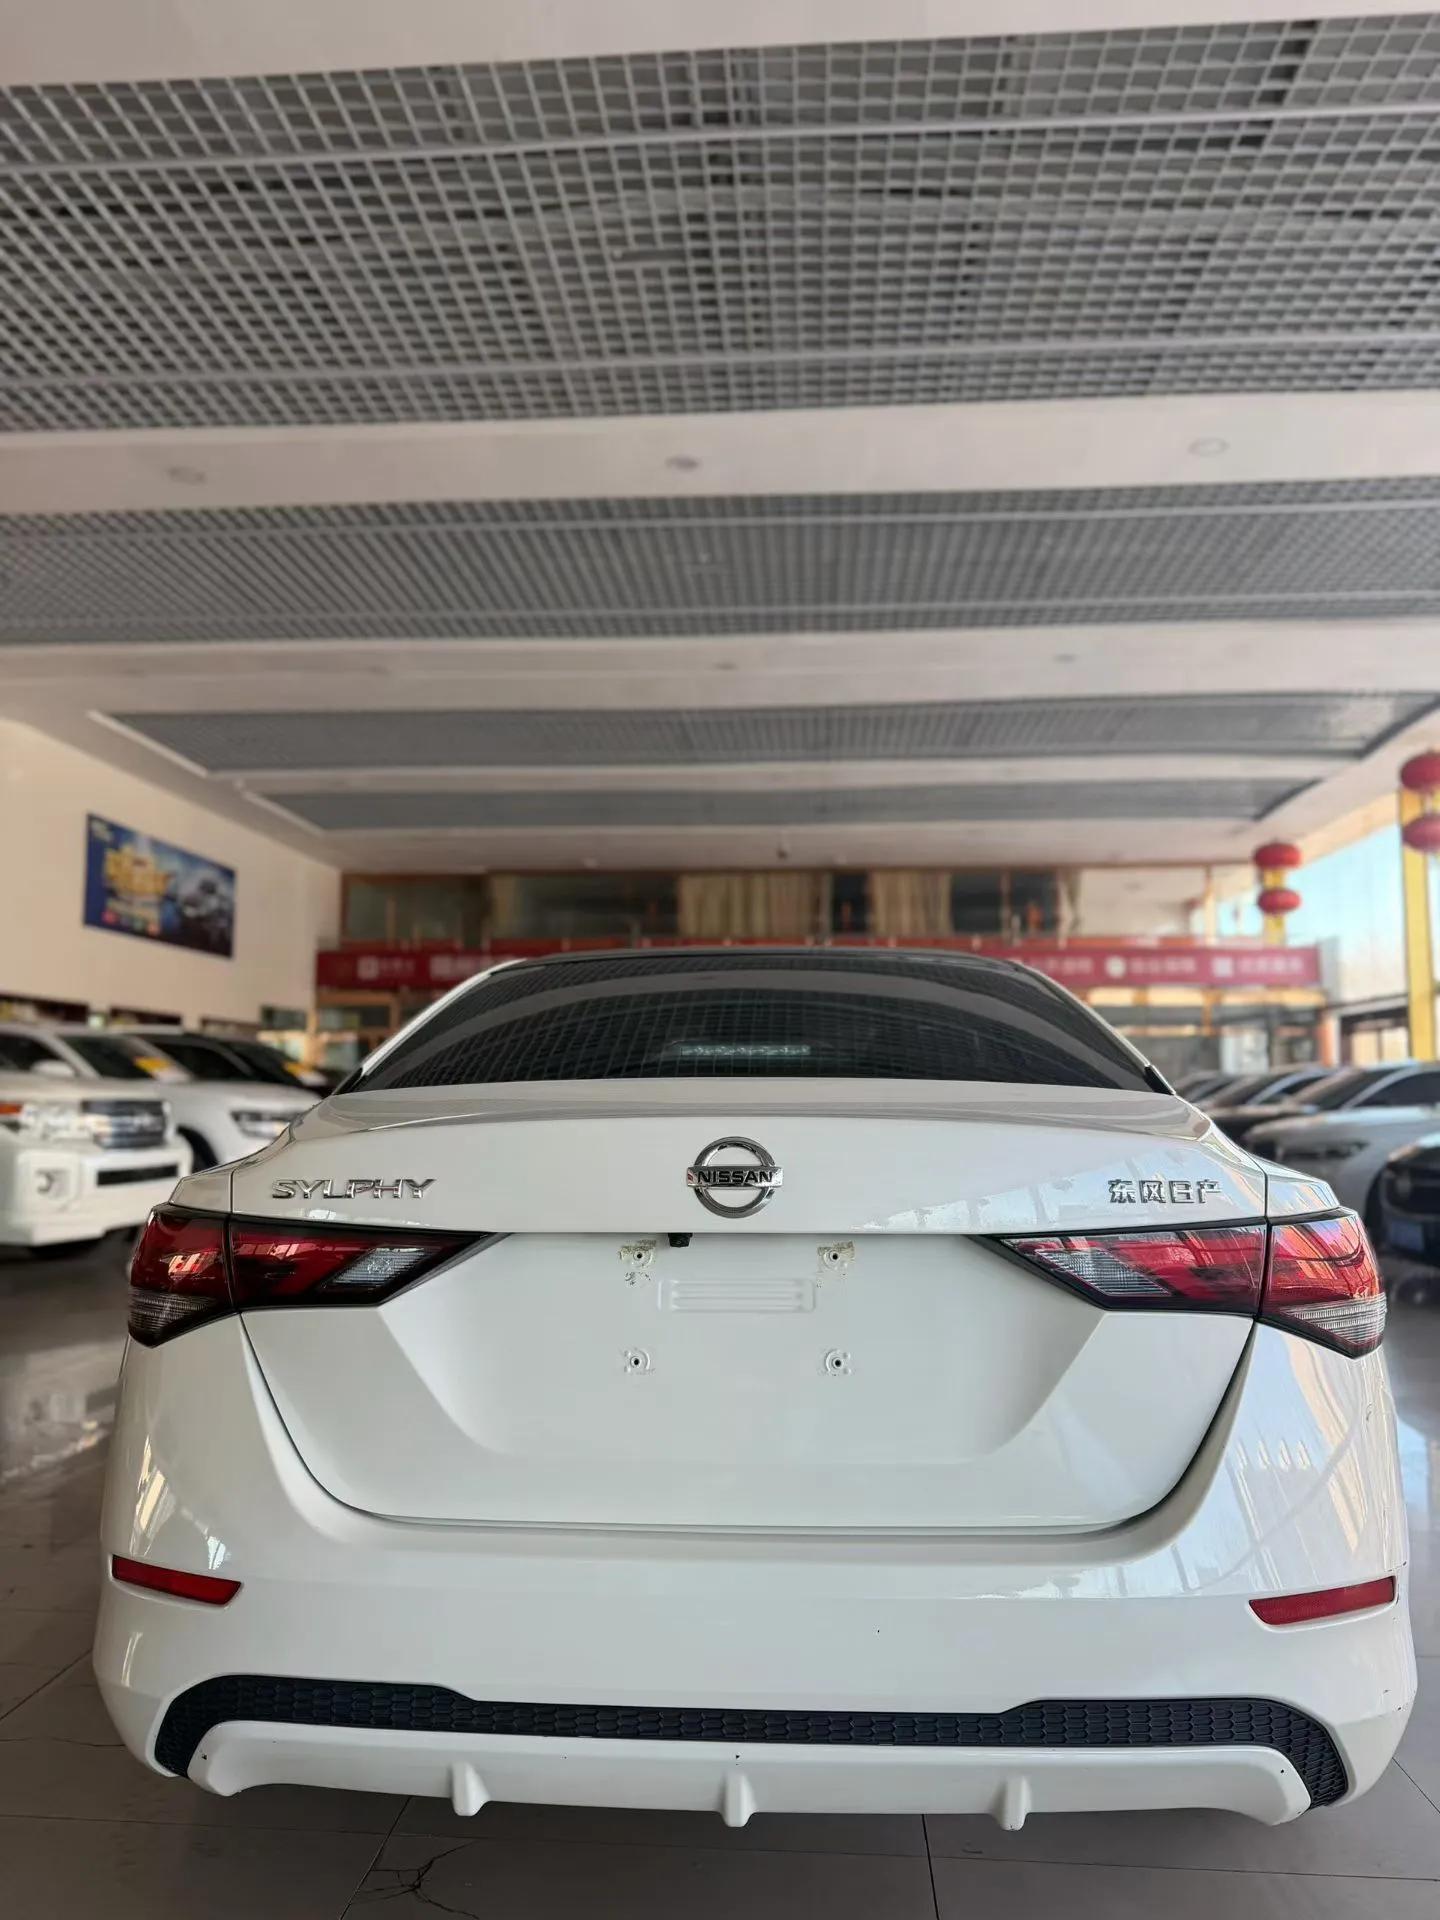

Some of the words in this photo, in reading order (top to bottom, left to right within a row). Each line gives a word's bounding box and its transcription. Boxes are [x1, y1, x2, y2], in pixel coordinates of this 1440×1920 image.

[697, 1170, 773, 1183] NISSAN
[272, 1178, 436, 1199] SYLPHY
[1108, 1179, 1222, 1203] 东风日产
